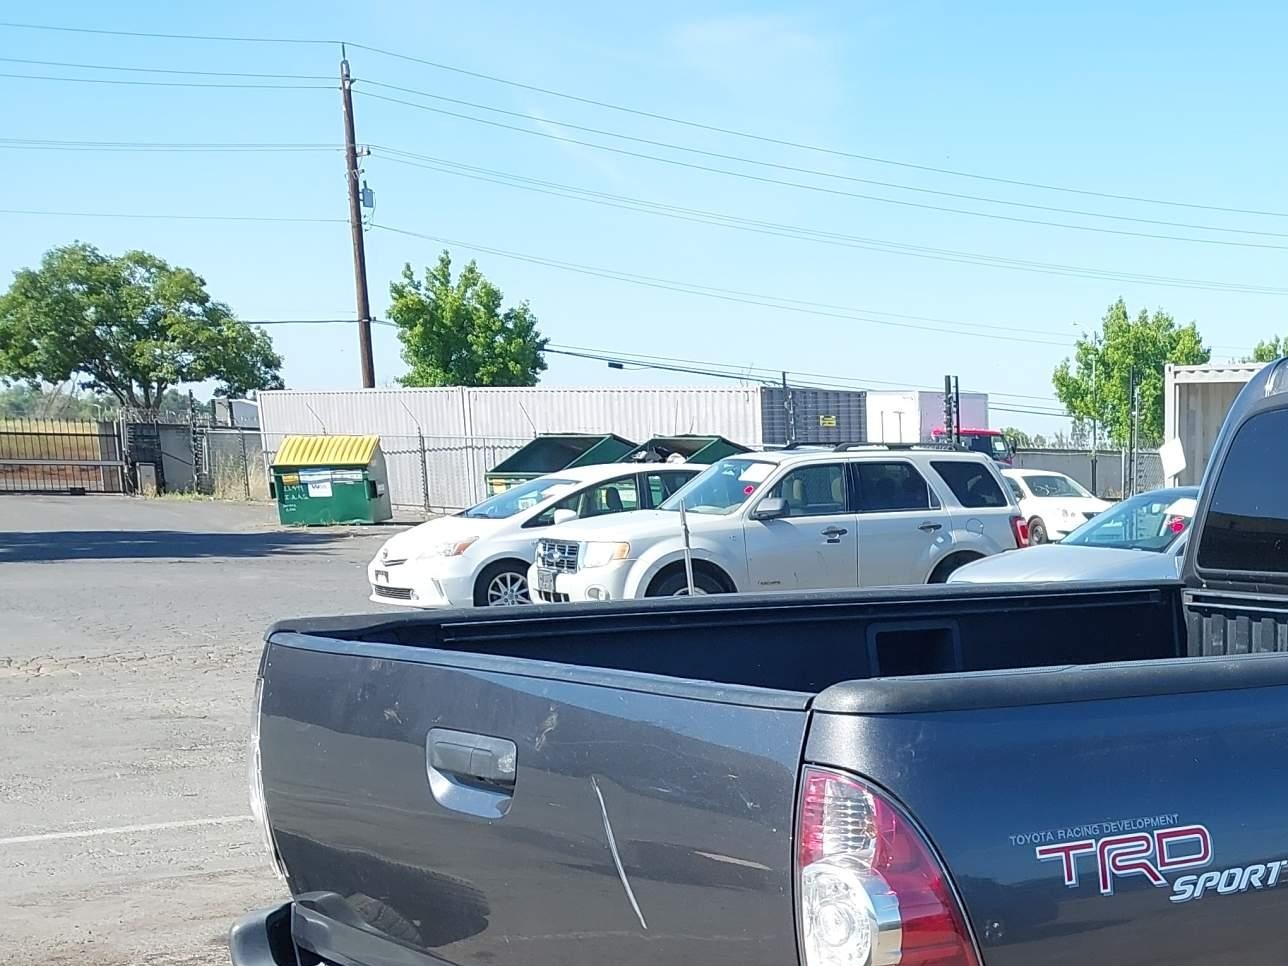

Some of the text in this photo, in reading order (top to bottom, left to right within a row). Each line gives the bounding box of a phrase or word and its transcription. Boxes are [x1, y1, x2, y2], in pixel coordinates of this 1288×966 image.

[1009, 813, 1179, 846] TOYOTA RACING DEVELOPMENT
[1036, 824, 1211, 895] TRD
[1169, 859, 1288, 902] SPORT
